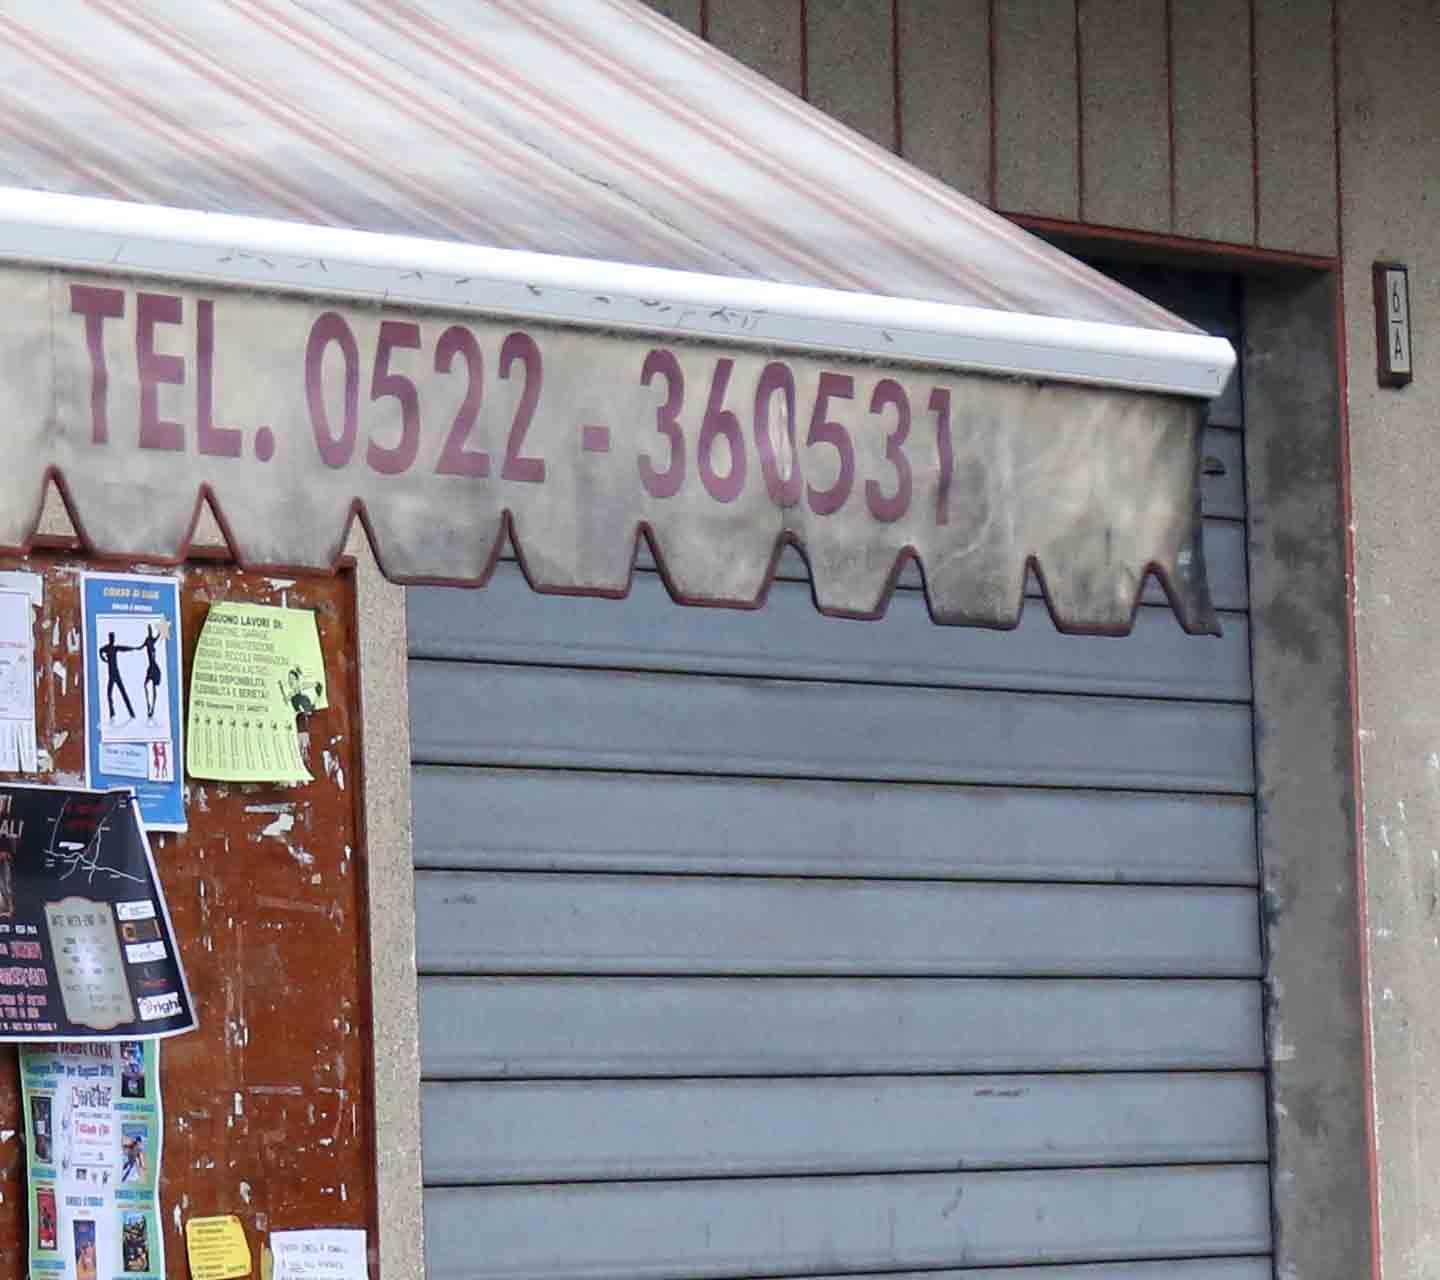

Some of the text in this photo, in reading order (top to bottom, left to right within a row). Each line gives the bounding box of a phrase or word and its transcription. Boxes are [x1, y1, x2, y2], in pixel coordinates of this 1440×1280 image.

[70, 285, 275, 462] TEL.
[305, 311, 545, 483] 0522
[638, 348, 953, 526] 360531
[241, 615, 270, 627] LAVORI
